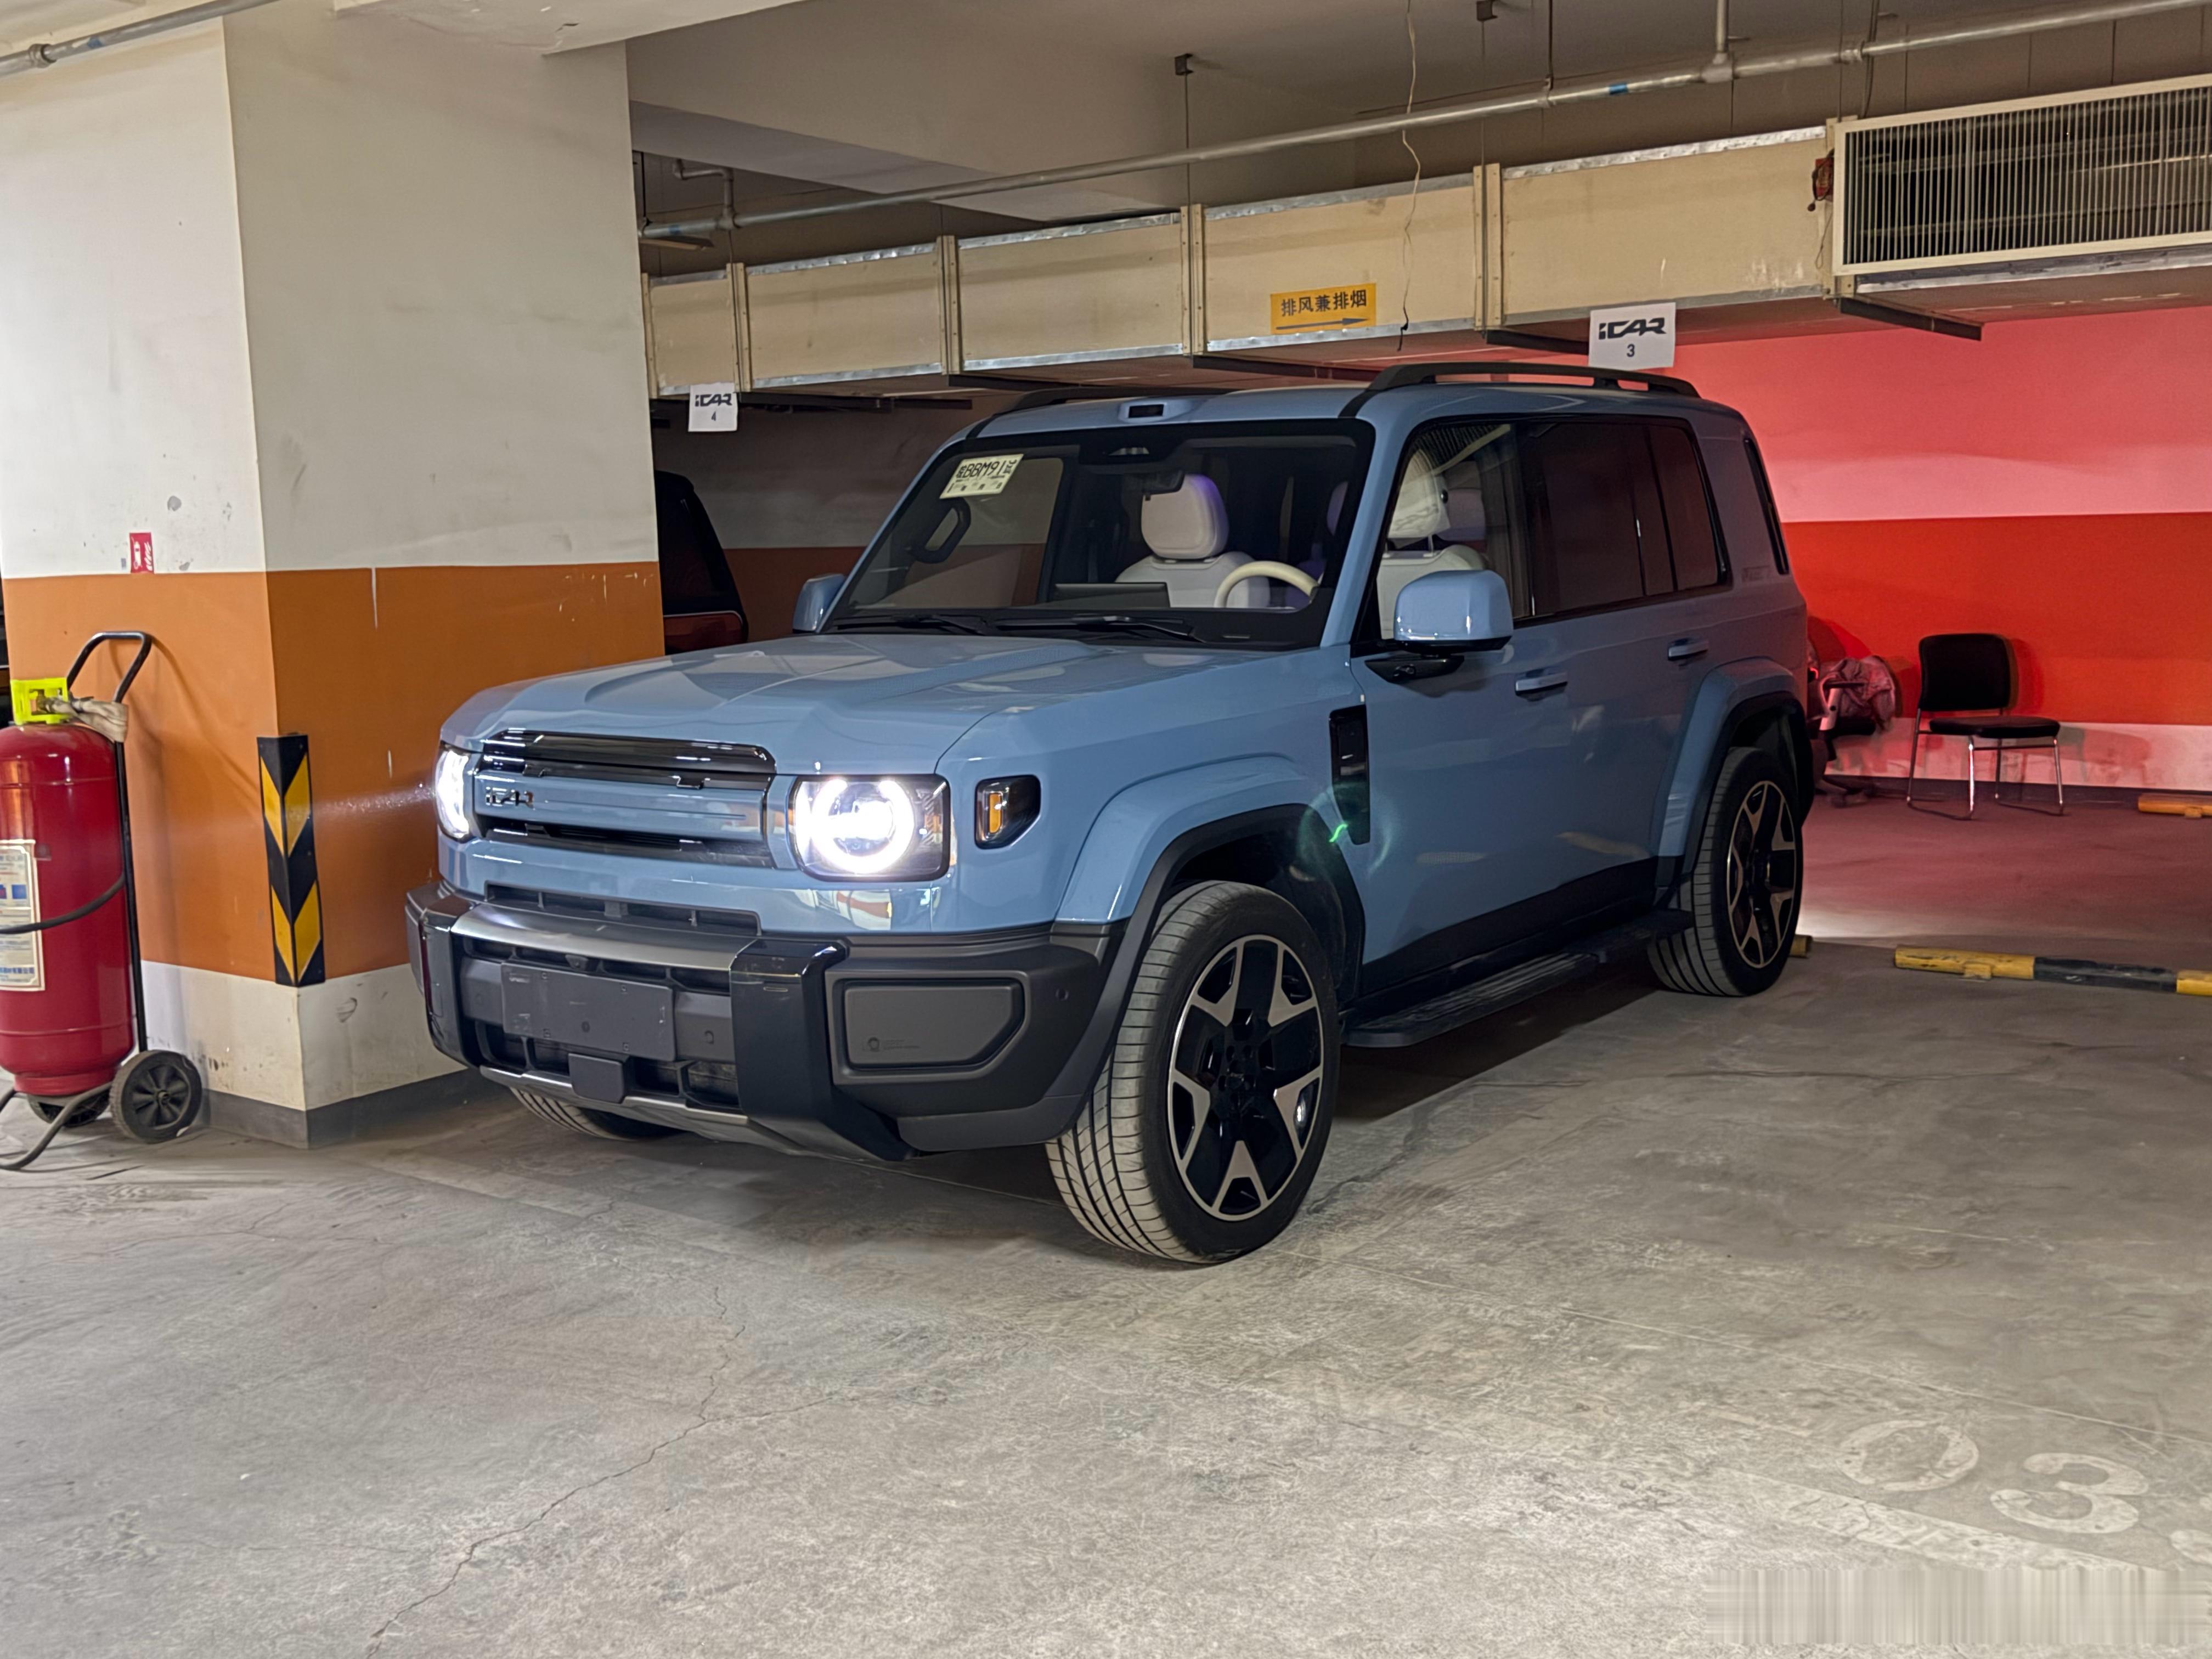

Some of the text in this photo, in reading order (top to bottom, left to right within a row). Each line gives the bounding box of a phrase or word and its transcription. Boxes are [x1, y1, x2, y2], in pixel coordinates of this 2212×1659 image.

[1281, 289, 1367, 317] 排风兼排烟
[1626, 343, 1635, 357] 3
[710, 410, 717, 421] 4
